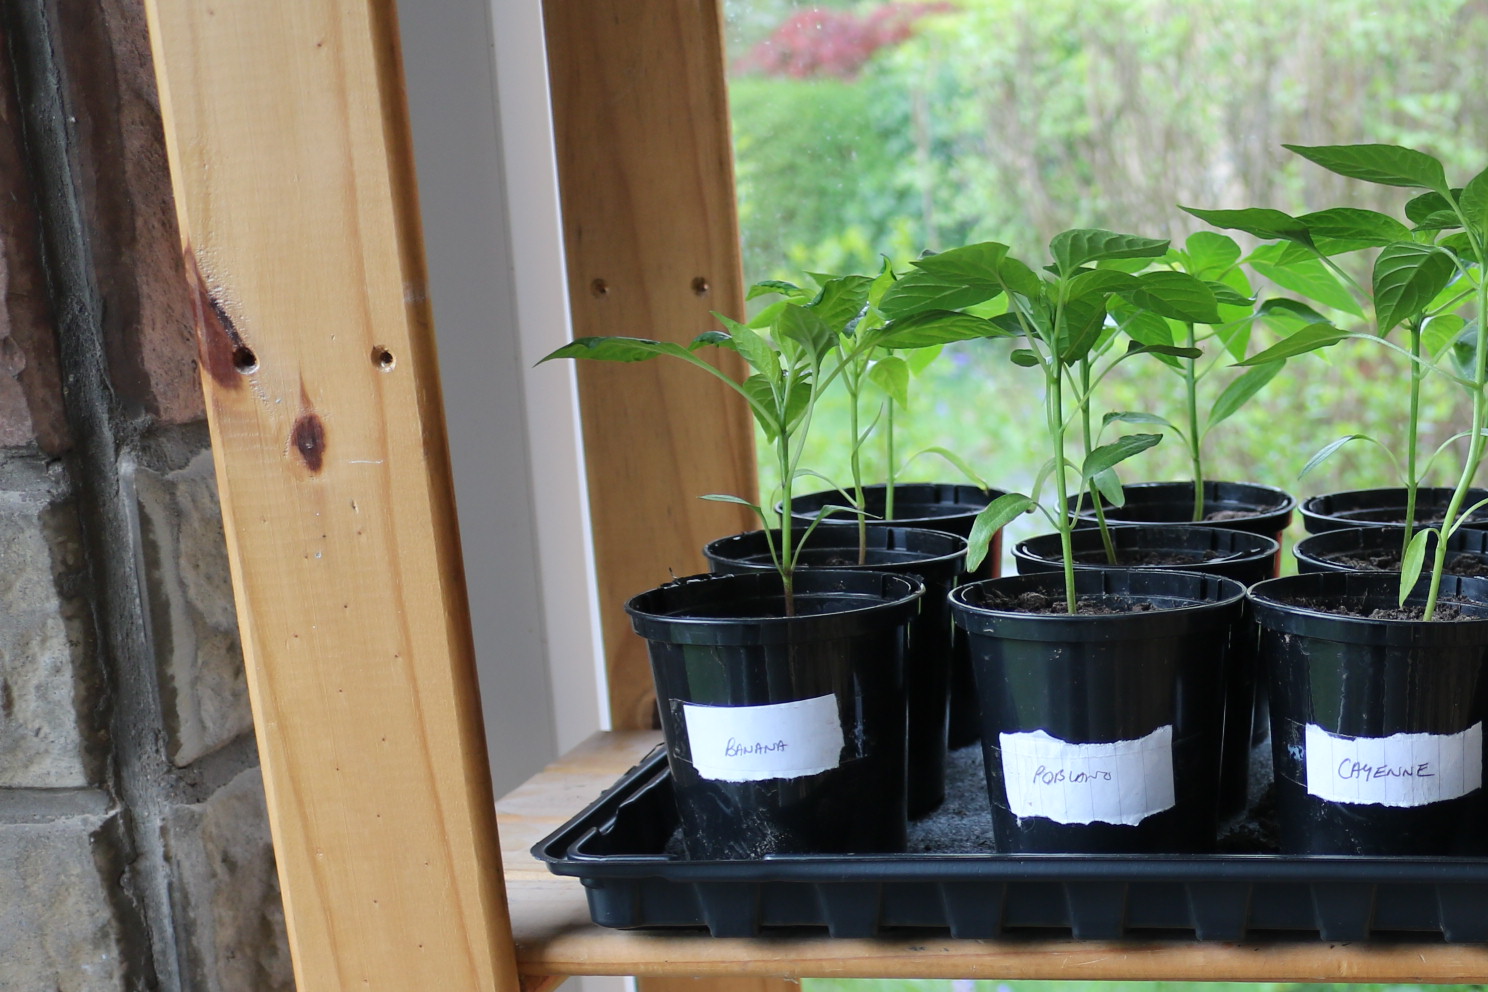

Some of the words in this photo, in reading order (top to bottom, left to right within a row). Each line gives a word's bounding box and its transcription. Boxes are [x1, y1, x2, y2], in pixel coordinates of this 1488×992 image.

[724, 736, 788, 757] BANANA
[1032, 764, 1112, 785] POBLANO
[1338, 757, 1436, 782] CAYENNE
